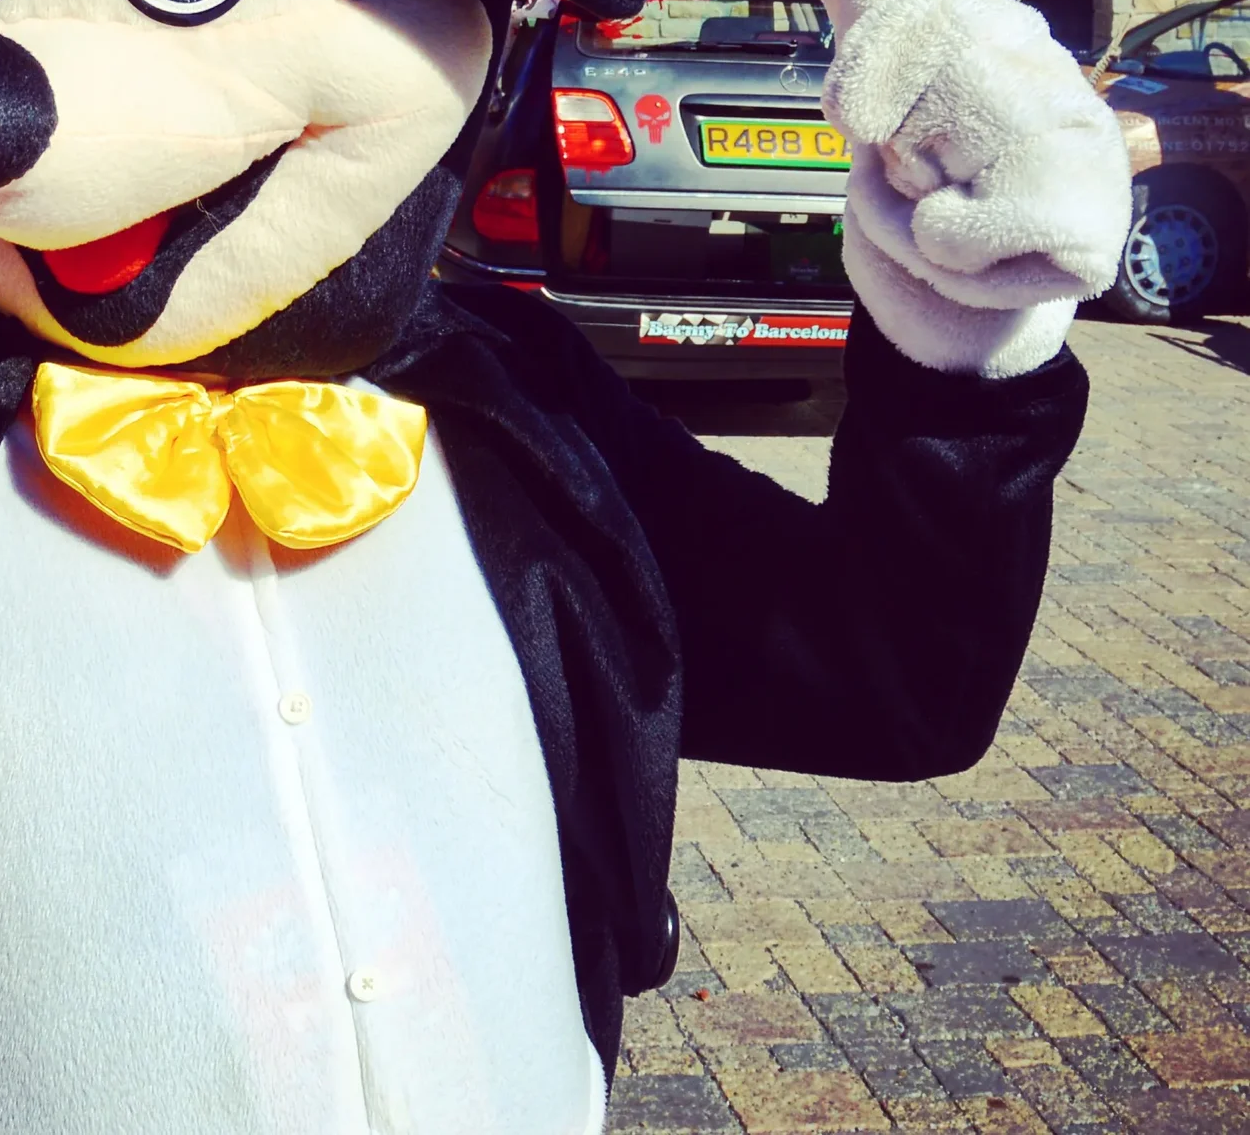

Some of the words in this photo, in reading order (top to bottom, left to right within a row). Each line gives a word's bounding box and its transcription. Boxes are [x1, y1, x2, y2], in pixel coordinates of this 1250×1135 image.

[707, 126, 803, 155] R488
[647, 320, 716, 340] Barmy
[725, 323, 751, 338] To
